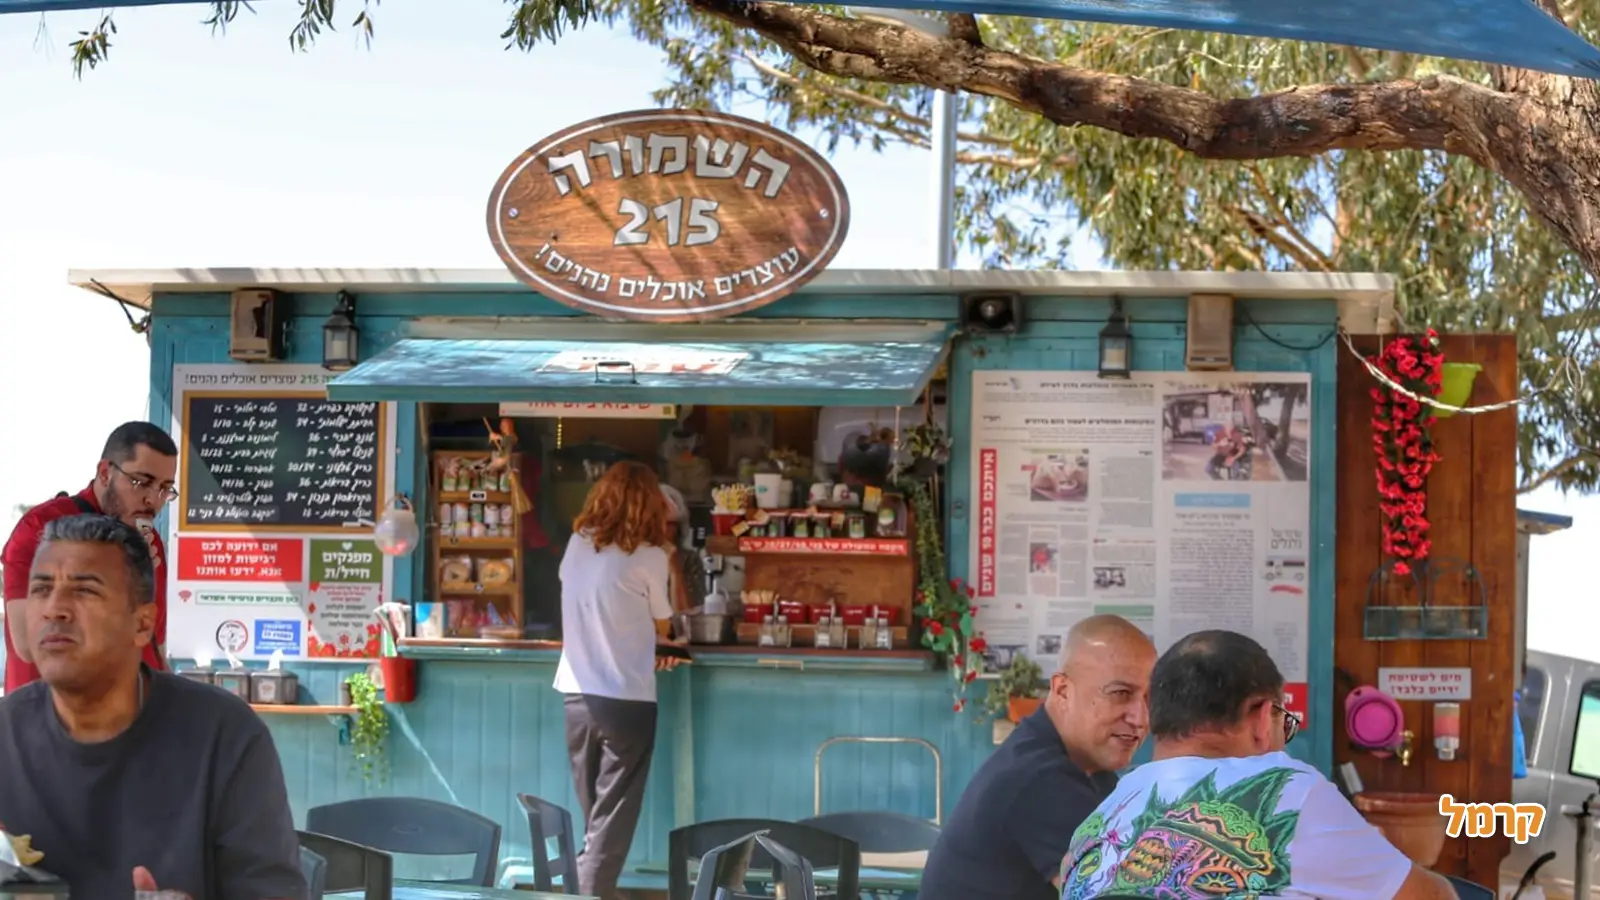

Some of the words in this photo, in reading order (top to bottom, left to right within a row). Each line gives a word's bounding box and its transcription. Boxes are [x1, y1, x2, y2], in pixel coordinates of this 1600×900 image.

[548, 132, 791, 198] השמורה
[613, 197, 721, 247] 215
[535, 243, 611, 292] נהנים!
[714, 246, 800, 294] עוצרים
[618, 275, 706, 301] אוכלים
[185, 373, 218, 385] נהנים!
[221, 372, 257, 385] אוכלים
[260, 374, 296, 385] עוצרים
[300, 374, 319, 385] 215
[201, 540, 223, 551] לכם
[262, 542, 278, 552] אם
[203, 552, 232, 565] למזון
[235, 553, 276, 564] רגישות
[322, 551, 372, 566] מפנקים
[196, 565, 226, 576] אותנו
[324, 565, 370, 579] חייל/ת
[1388, 672, 1436, 682] לשטיפת
[1440, 673, 1462, 682] מים
[1429, 685, 1459, 695] ידיים
